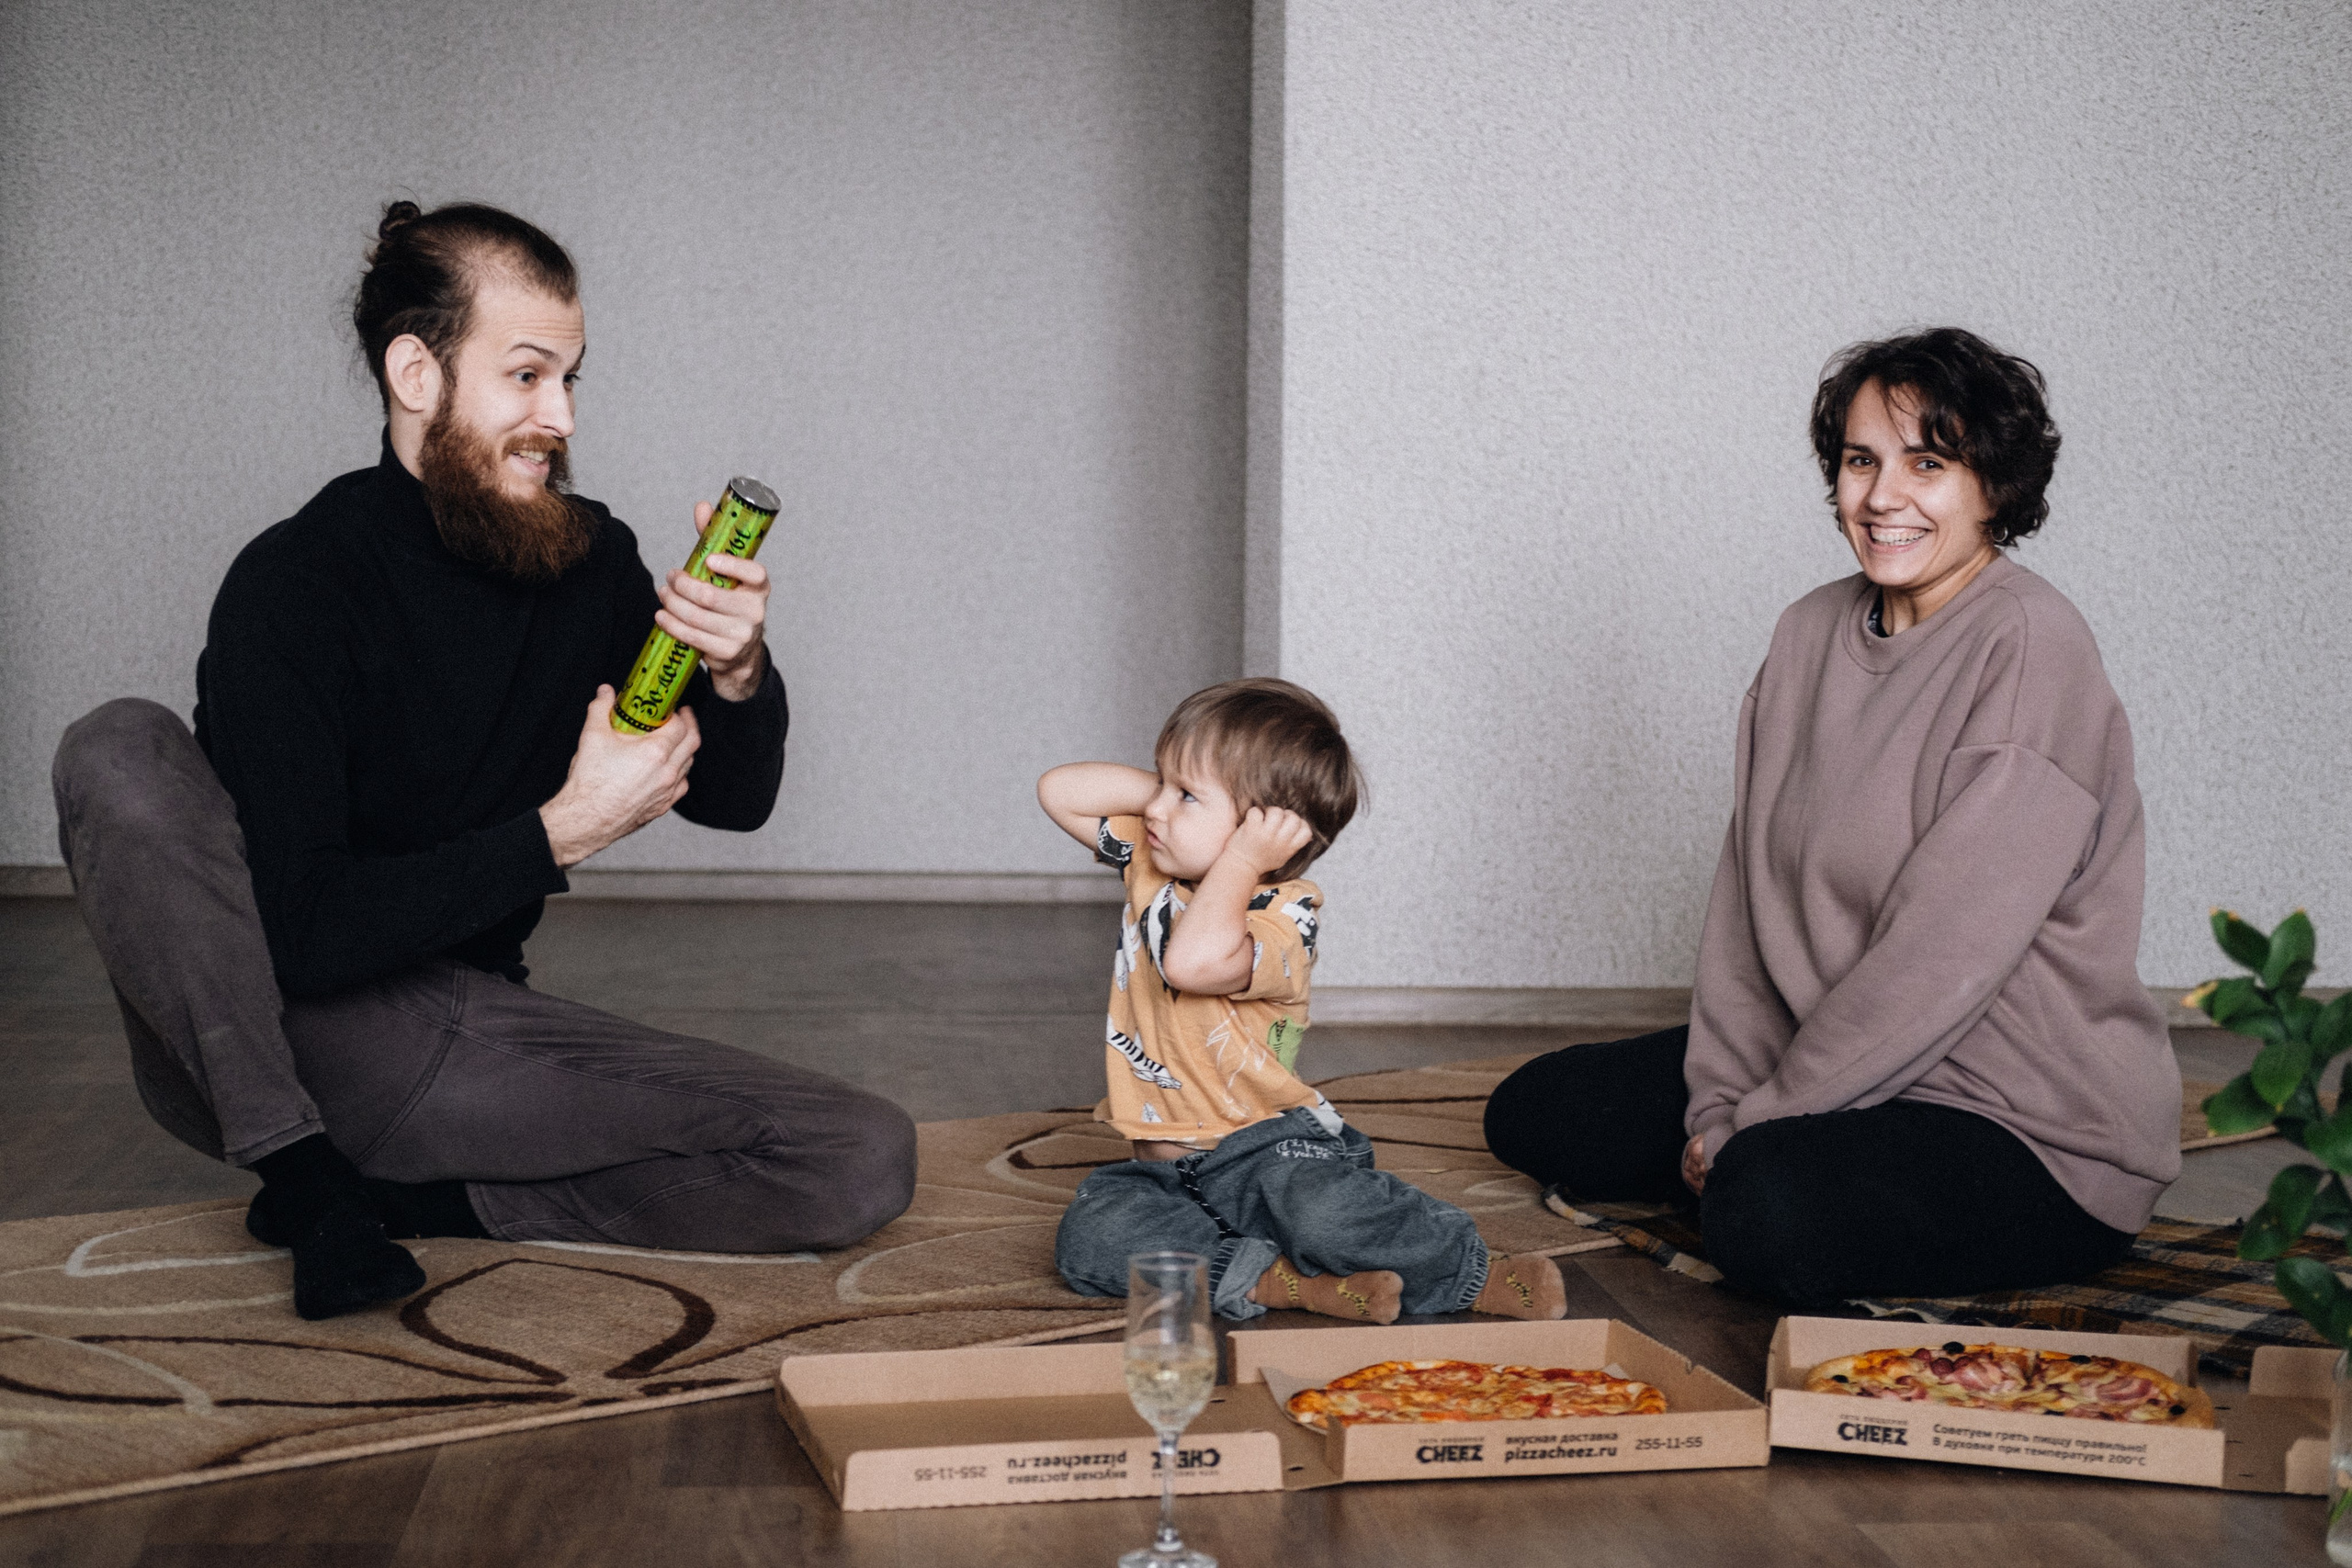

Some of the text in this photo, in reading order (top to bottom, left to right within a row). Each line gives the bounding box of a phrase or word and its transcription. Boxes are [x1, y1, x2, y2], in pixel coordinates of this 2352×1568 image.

[1506, 1433, 1618, 1447] вкусная доставка
[1838, 1421, 1908, 1447] CHEEZ
[1933, 1423, 1992, 1438] Советуем
[1996, 1430, 2030, 1442] греть
[1635, 1436, 1703, 1450] 255-11-55
[1933, 1436, 1940, 1446] В
[1943, 1438, 1995, 1451] духовке
[1997, 1444, 2021, 1454] при
[2023, 1447, 2104, 1463] температуре
[1008, 1450, 1127, 1469] pizzacheez.ru
[1151, 1449, 1221, 1470] CHEZ
[1417, 1444, 1484, 1464] CHEEZ
[1504, 1446, 1618, 1463] pizzacheez.ru
[914, 1465, 988, 1482] 255-11-55
[1008, 1469, 1127, 1484] вкусная доставка
